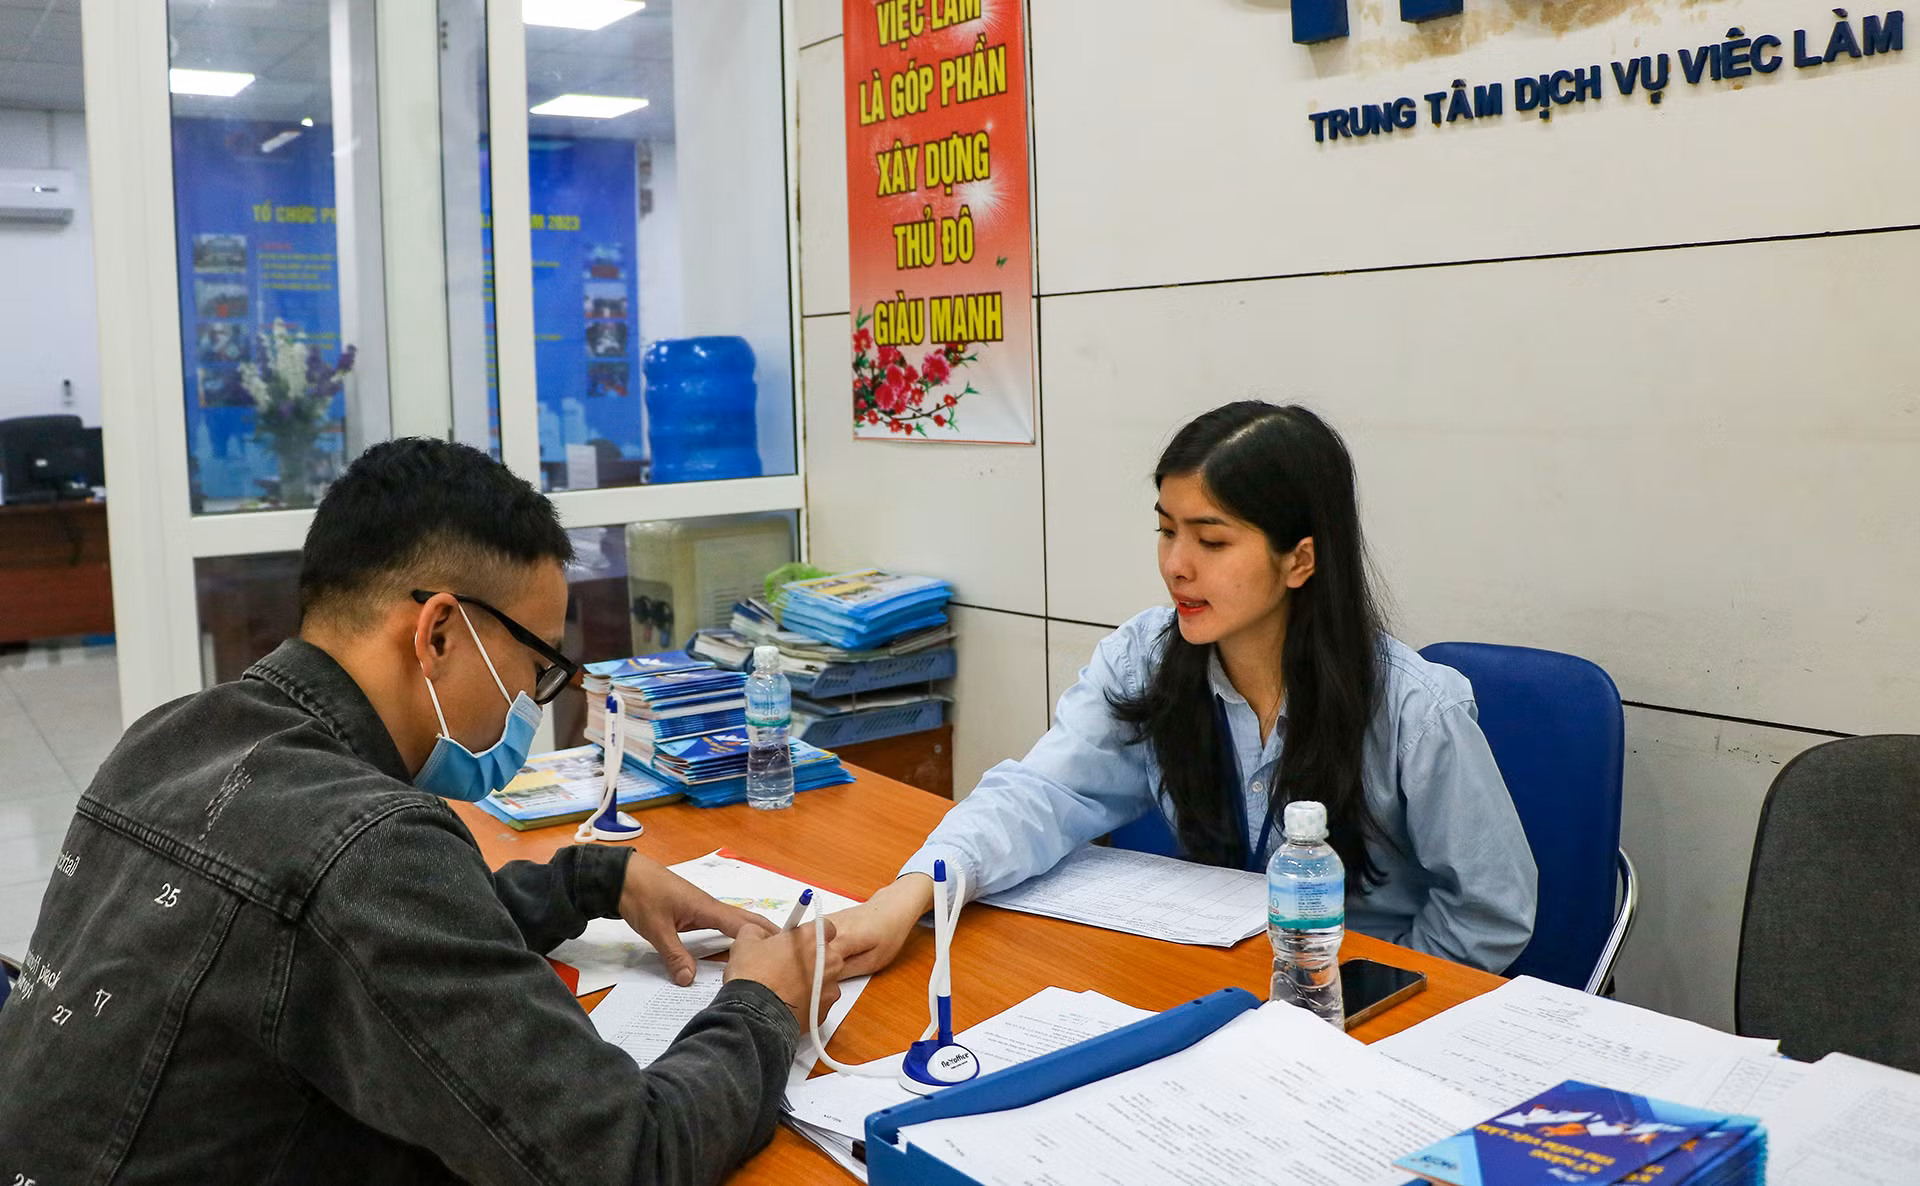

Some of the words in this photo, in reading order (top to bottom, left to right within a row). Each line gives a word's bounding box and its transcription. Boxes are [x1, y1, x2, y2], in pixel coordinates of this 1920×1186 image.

[859, 68, 886, 128] LÀ
[890, 58, 934, 119] GÓP
[940, 33, 1007, 107] PHẦN
[1308, 97, 1417, 142] TRUNG
[1424, 79, 1503, 124] TÂM
[1515, 65, 1602, 119] DỊCH
[1610, 53, 1669, 104] VỤ
[1794, 8, 1904, 67] LÀM
[876, 138, 919, 197] XÂY
[924, 131, 990, 196] DỰNG
[893, 204, 935, 270] THỦ
[941, 204, 975, 265] ĐÔ
[874, 290, 924, 346] GIÀU
[929, 291, 1003, 352] MẠNH
[154, 883, 181, 907] 25
[52, 1005, 72, 1026] 27
[94, 988, 112, 1017] 17
